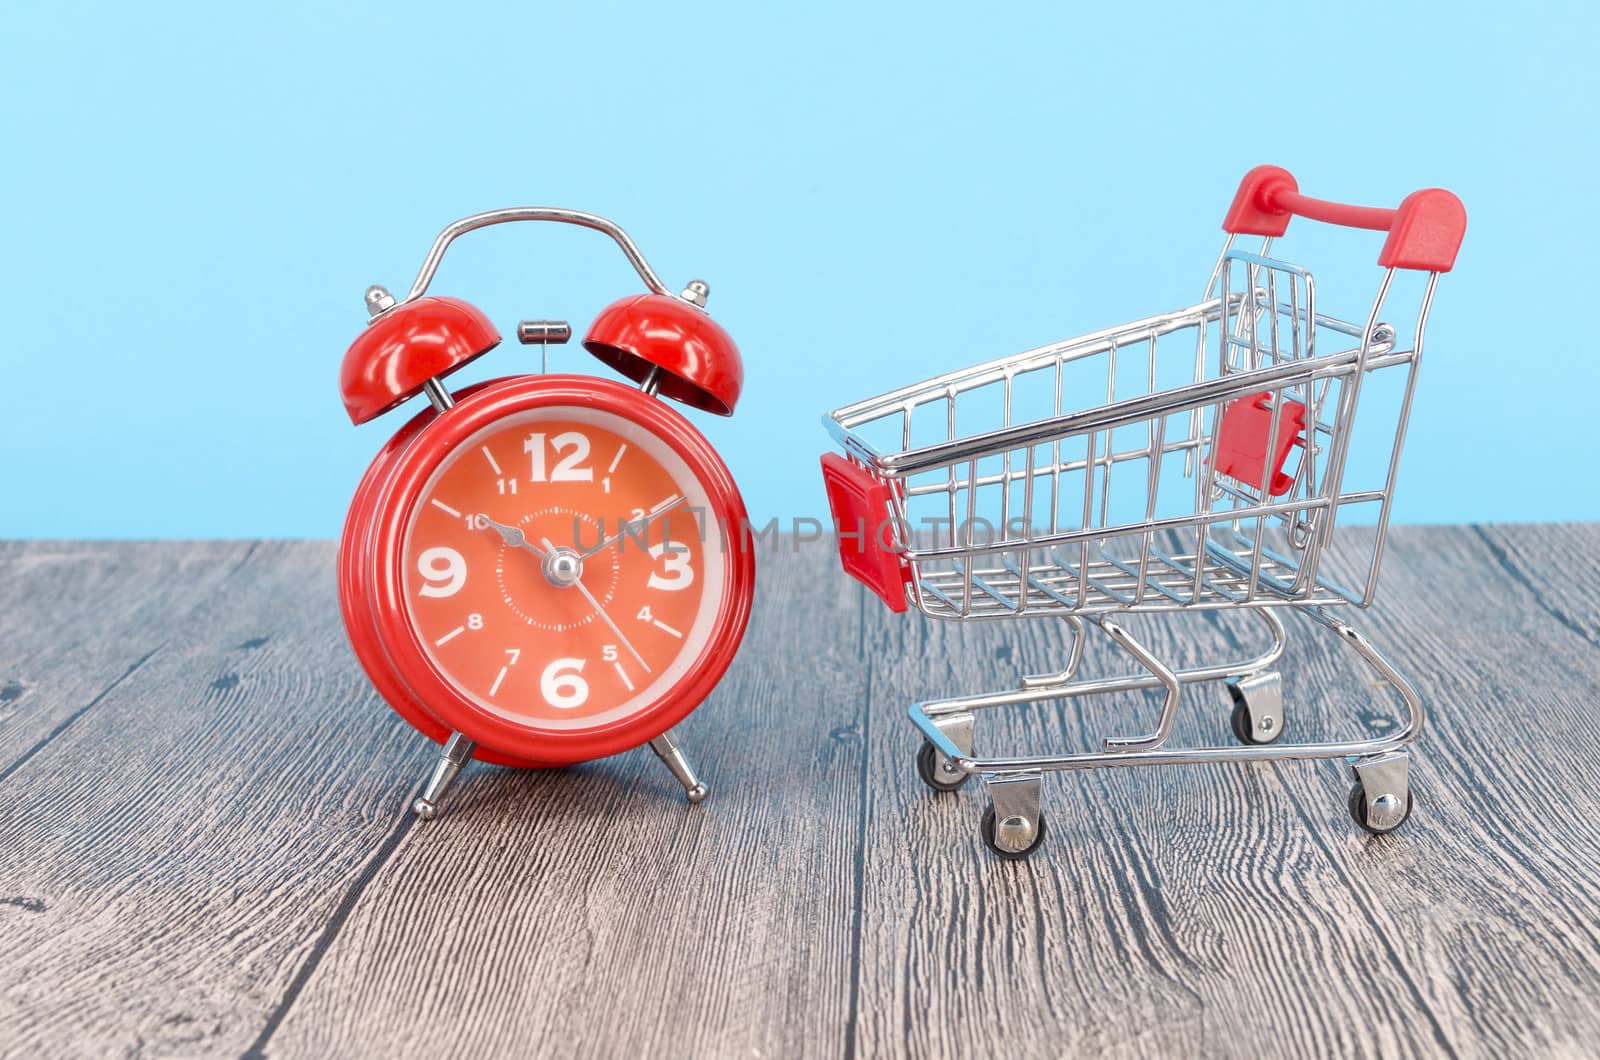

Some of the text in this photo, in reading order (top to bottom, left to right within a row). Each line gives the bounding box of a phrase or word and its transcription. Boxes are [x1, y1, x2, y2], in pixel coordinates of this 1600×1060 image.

[523, 432, 593, 483] 12
[496, 479, 518, 495] 11
[602, 478, 611, 494] 1
[465, 513, 490, 530] 10
[417, 546, 467, 598] 9
[646, 541, 694, 592] 3
[467, 614, 484, 630] 8
[637, 605, 653, 622] 4
[505, 649, 521, 665] 7
[602, 645, 618, 661] 5
[540, 657, 590, 709] 6
